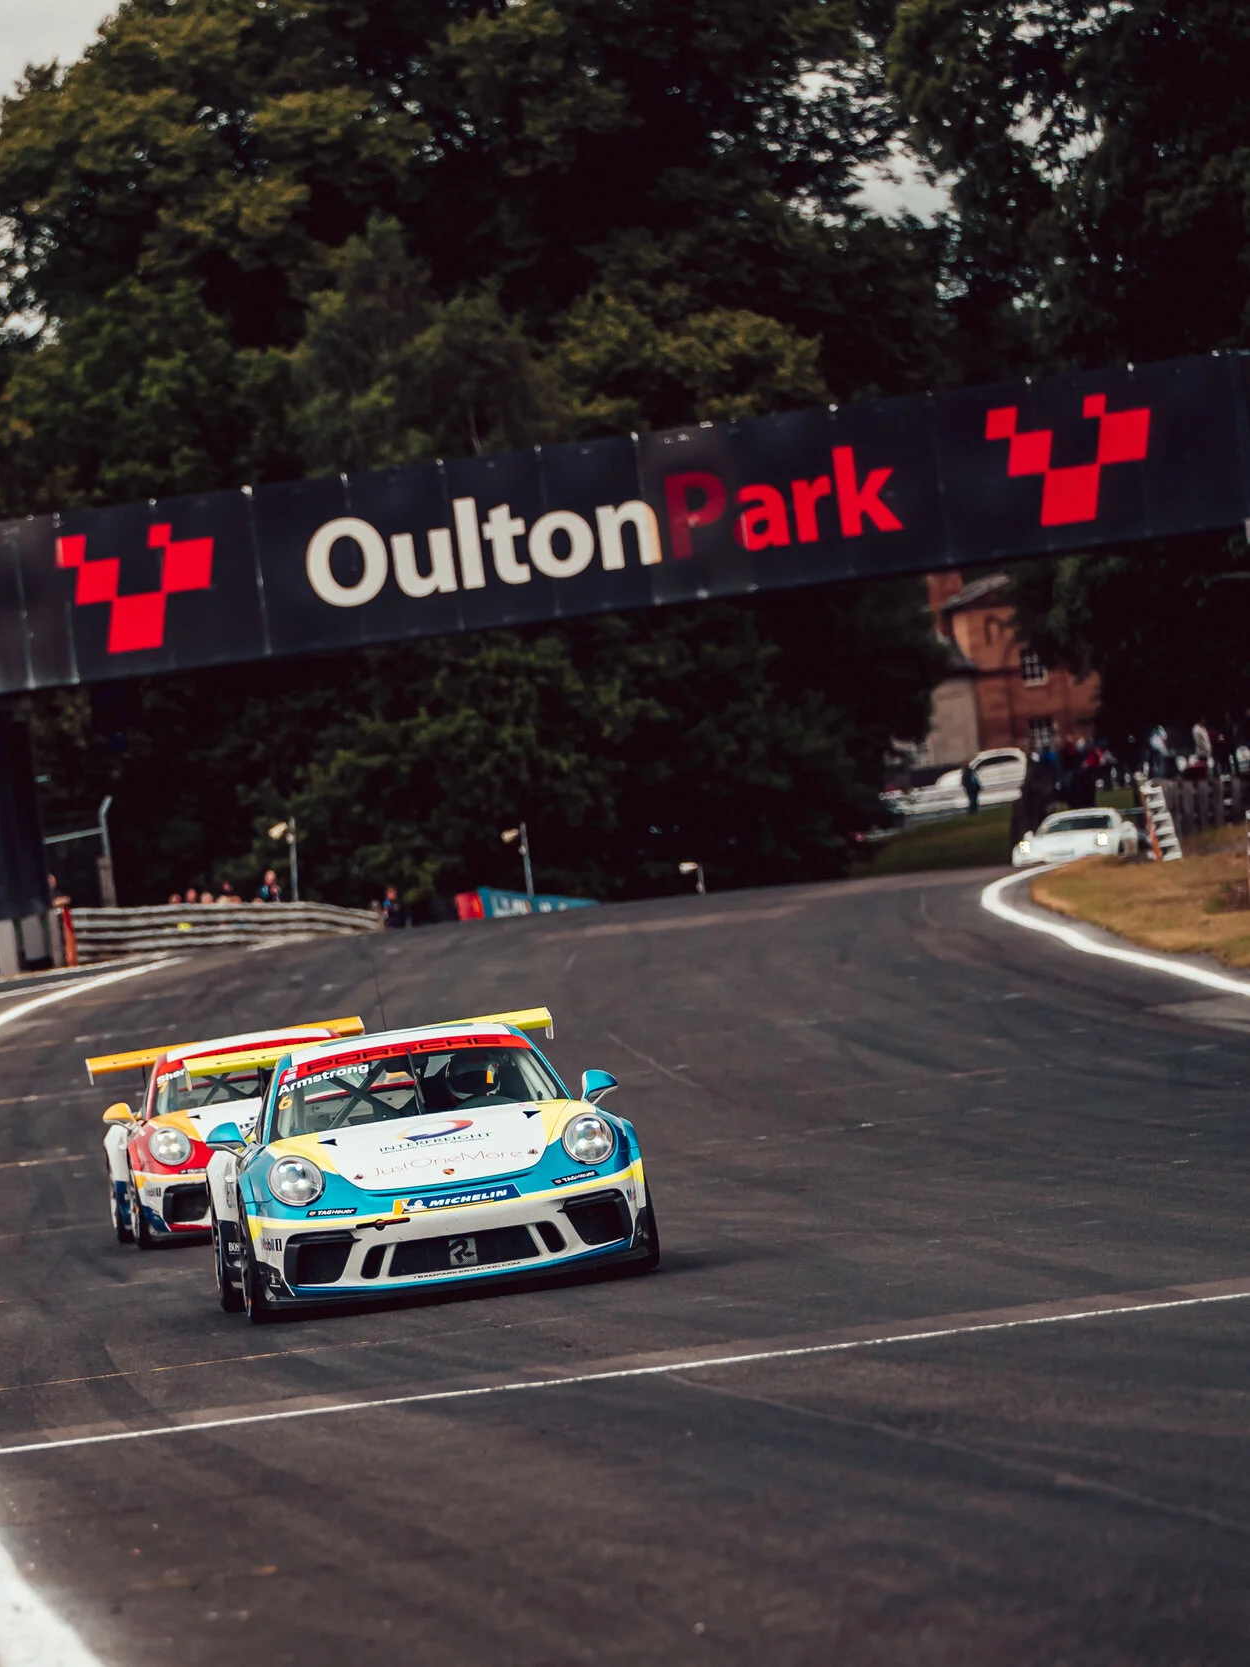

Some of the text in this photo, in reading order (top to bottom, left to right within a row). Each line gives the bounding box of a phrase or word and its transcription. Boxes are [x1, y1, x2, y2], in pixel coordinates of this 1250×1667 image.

[306, 1035, 502, 1074] PORSCHE
[156, 1069, 185, 1085] Sher
[278, 1063, 370, 1096] Armstrong
[278, 1095, 293, 1110] 6
[379, 1132, 492, 1152] INTERFREIGHT
[429, 1189, 508, 1207] MICHELIN
